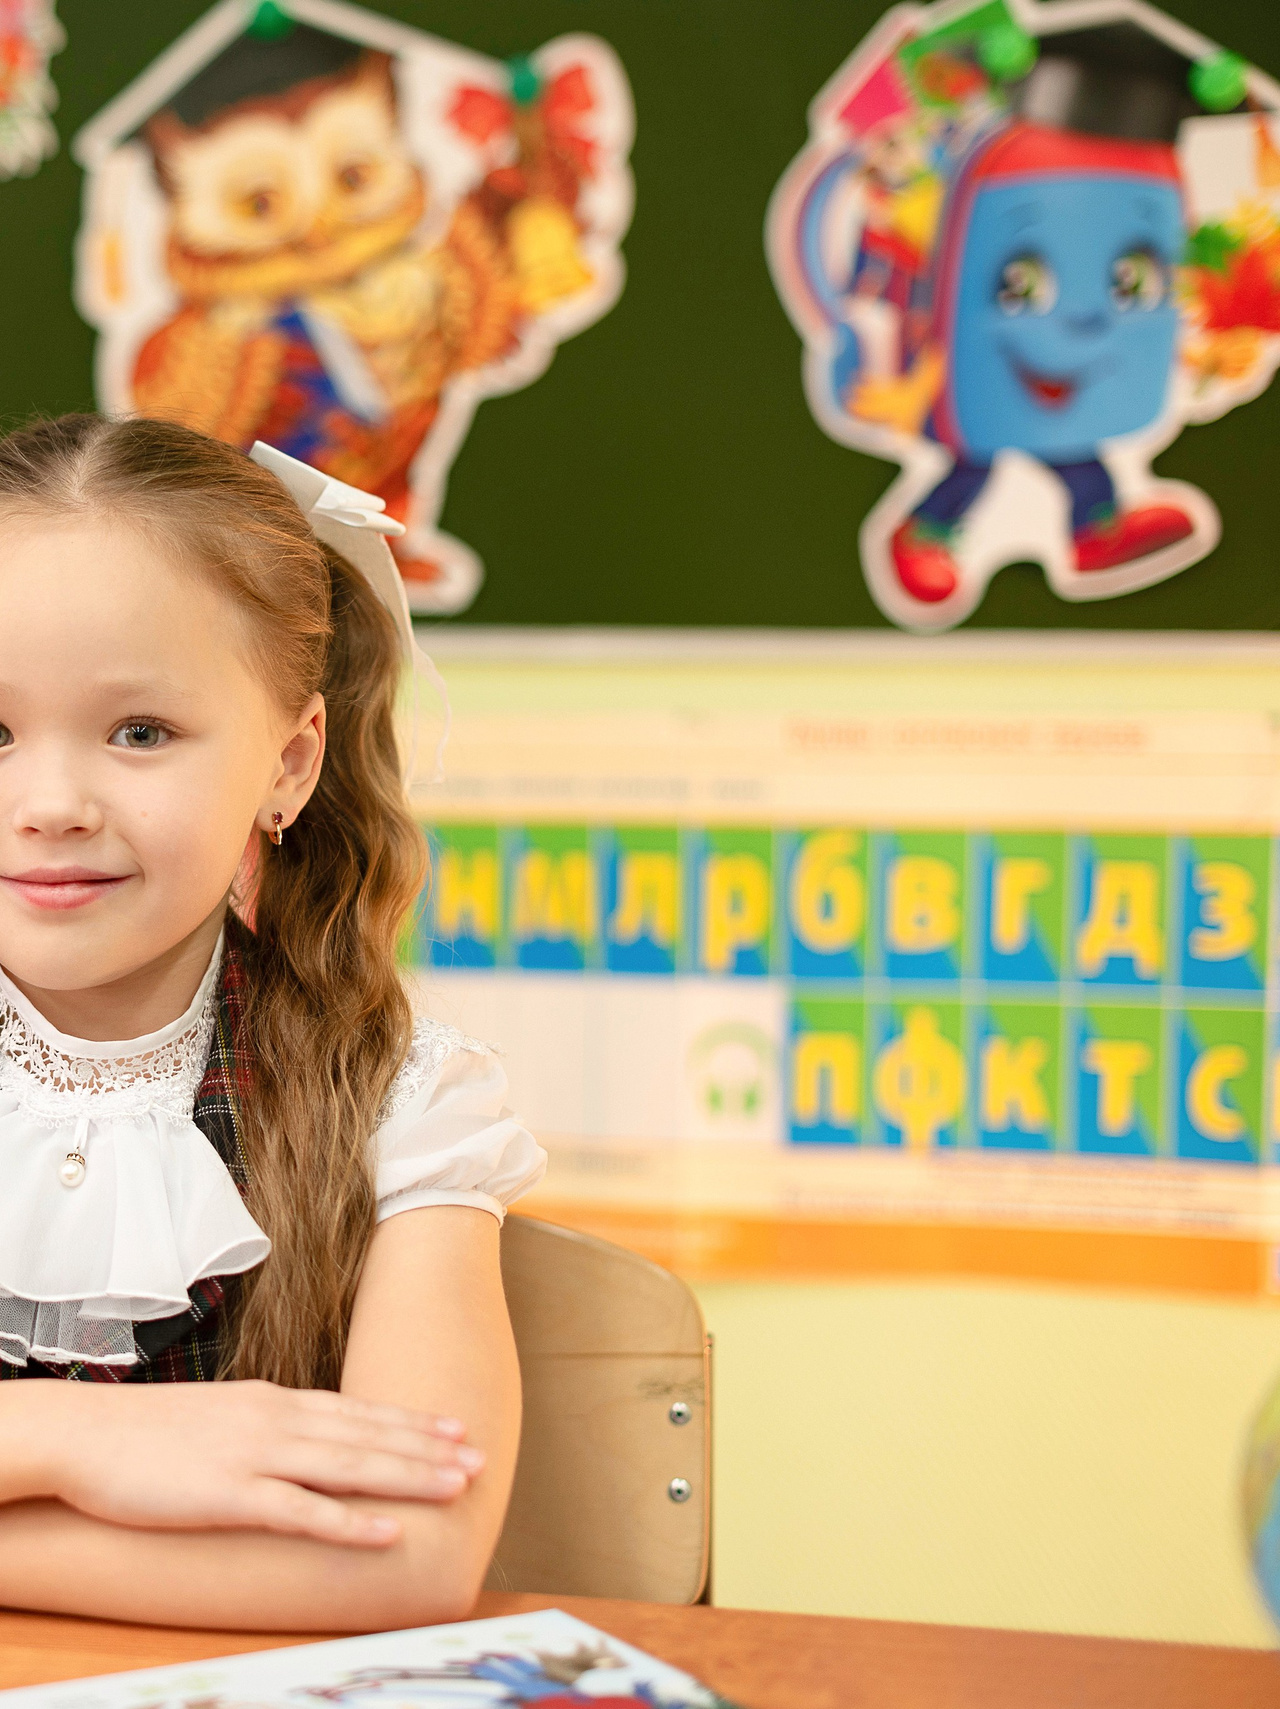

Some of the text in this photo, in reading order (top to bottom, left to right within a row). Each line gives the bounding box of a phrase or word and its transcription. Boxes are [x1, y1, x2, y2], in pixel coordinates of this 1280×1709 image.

[436, 850, 496, 936] н
[611, 851, 677, 943] л
[704, 853, 770, 970] р
[792, 829, 865, 953] б
[887, 856, 960, 953] в
[991, 858, 1052, 954] г
[1078, 861, 1162, 979] д
[1188, 862, 1257, 961] з
[794, 1032, 861, 1126] п
[874, 1006, 966, 1157] ф
[982, 1035, 1050, 1134] к
[1085, 1039, 1152, 1136] т
[1186, 1046, 1248, 1142] с
